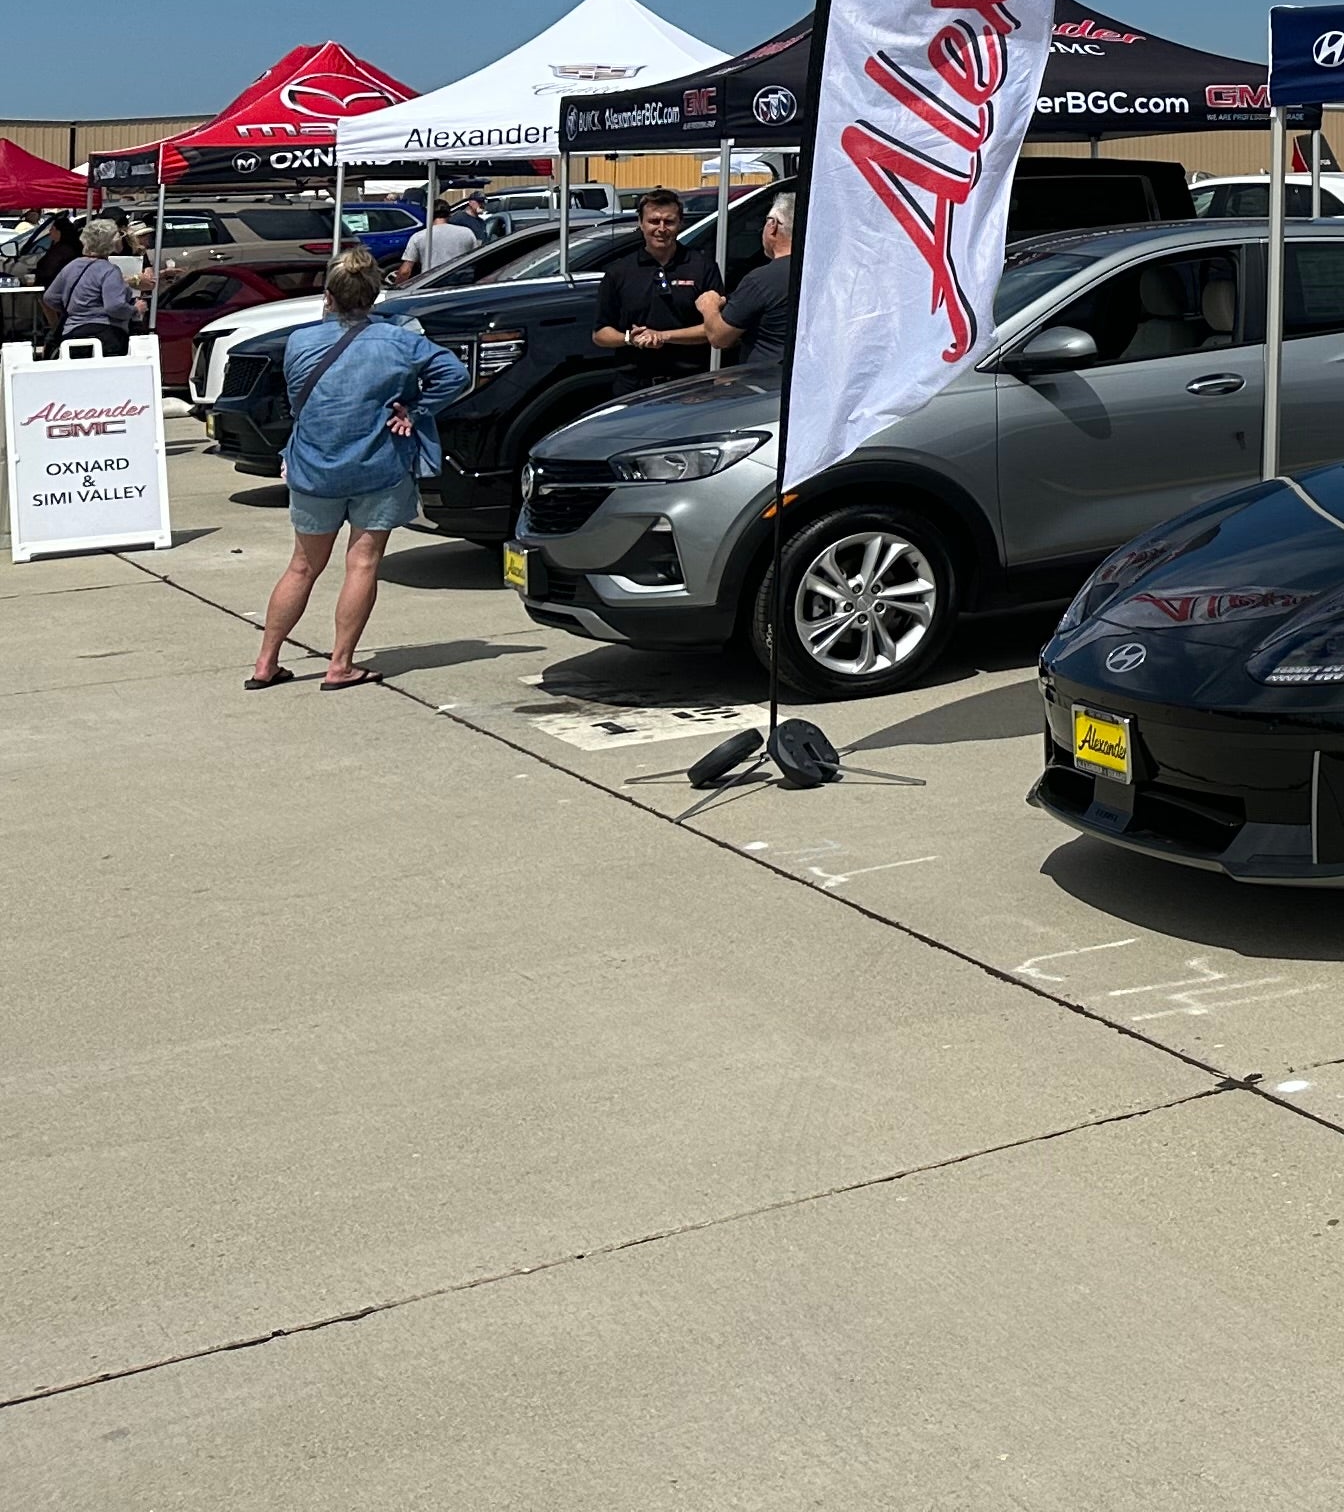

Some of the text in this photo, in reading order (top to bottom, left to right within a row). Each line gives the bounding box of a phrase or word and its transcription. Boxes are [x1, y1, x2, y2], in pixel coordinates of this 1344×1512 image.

[578, 109, 602, 132] BUICK
[604, 101, 681, 130] AlexanderBGC.com
[683, 87, 718, 116] GMC
[1033, 84, 1303, 114] erBGC.com GM
[404, 123, 557, 149] Alexander
[20, 399, 149, 426] Alexander
[46, 419, 126, 439] GMC
[46, 457, 129, 476] OXNARD
[82, 475, 96, 488] &
[32, 485, 147, 507] SIMI VALLEY
